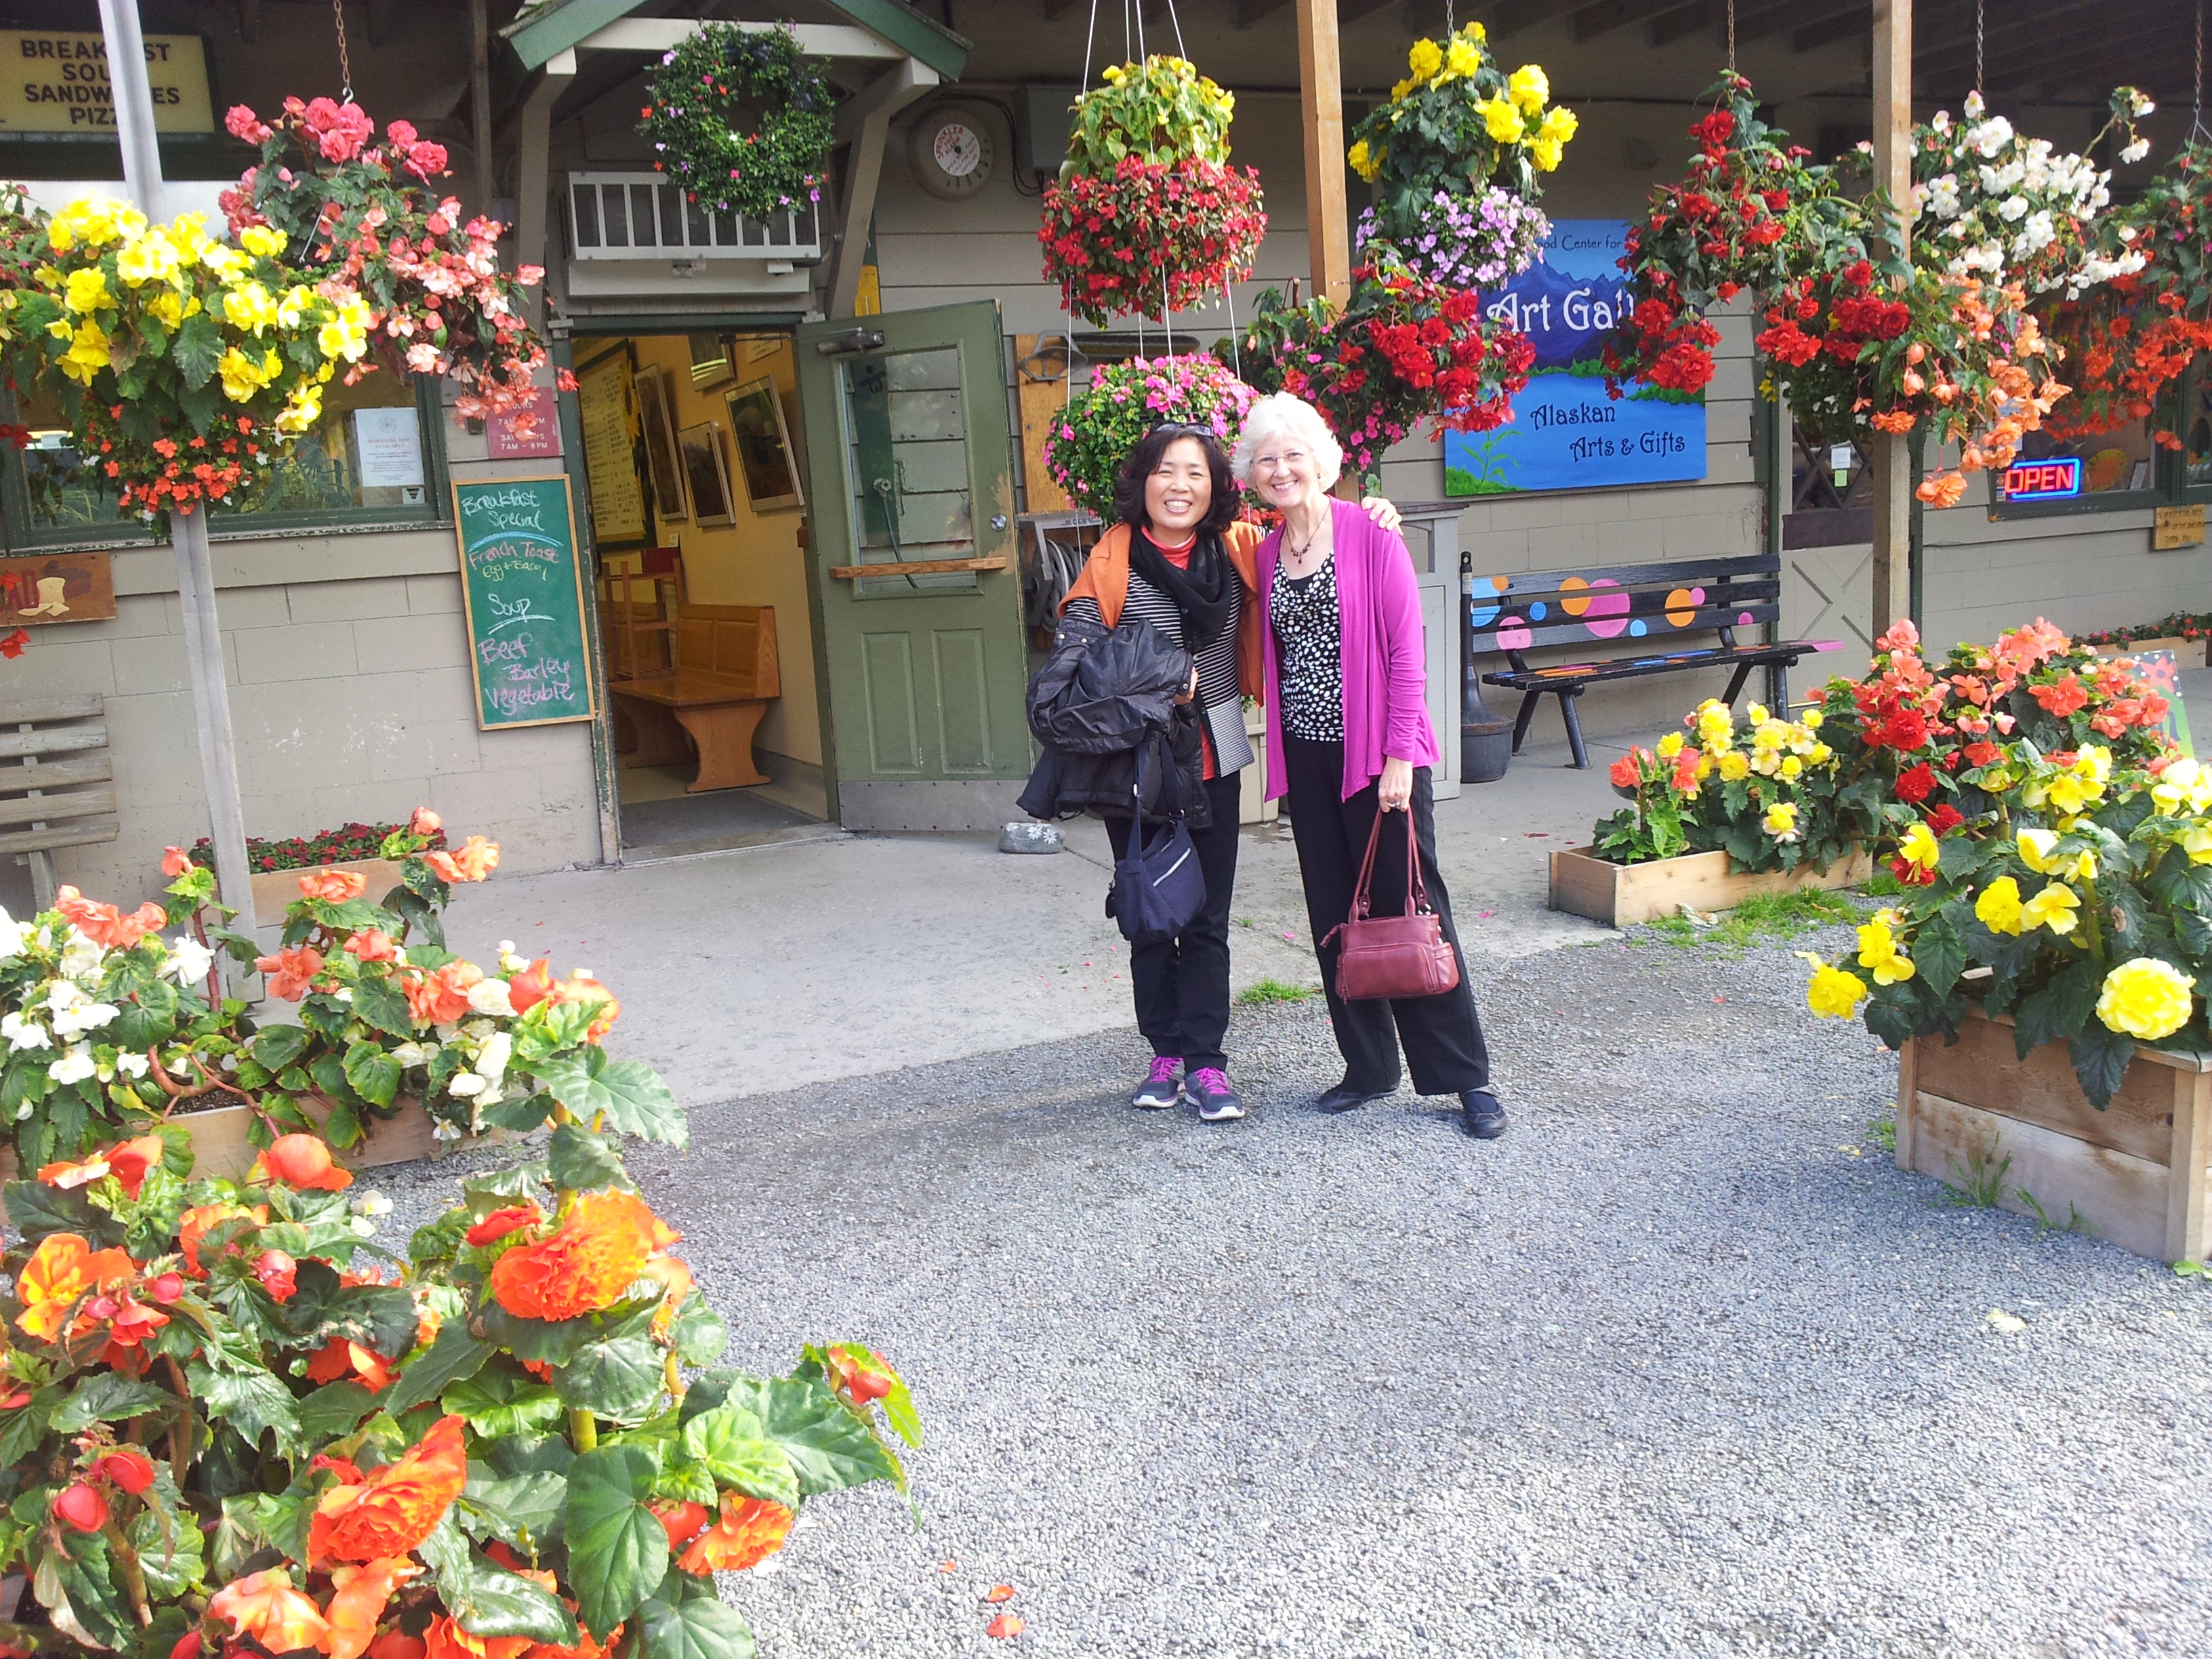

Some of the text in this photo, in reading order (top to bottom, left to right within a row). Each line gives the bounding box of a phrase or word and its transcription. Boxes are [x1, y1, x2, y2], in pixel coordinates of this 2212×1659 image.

[20, 39, 170, 61] BREAKST
[62, 63, 111, 82] SOU
[24, 84, 180, 105] SANDWES
[70, 107, 117, 125] PIZZ
[1535, 234, 1622, 251] ood Center for
[1486, 287, 1635, 335] Art Gall
[1530, 401, 1616, 431] Alaskan
[1569, 430, 1686, 464] Arts & Gifts
[2005, 465, 2074, 493] OPEN
[462, 489, 540, 516] Breakfast
[488, 510, 545, 531] Special
[468, 541, 558, 570] French Toast
[478, 632, 533, 665] Beef
[502, 657, 570, 685] Barley
[485, 680, 575, 716] Vegetable
